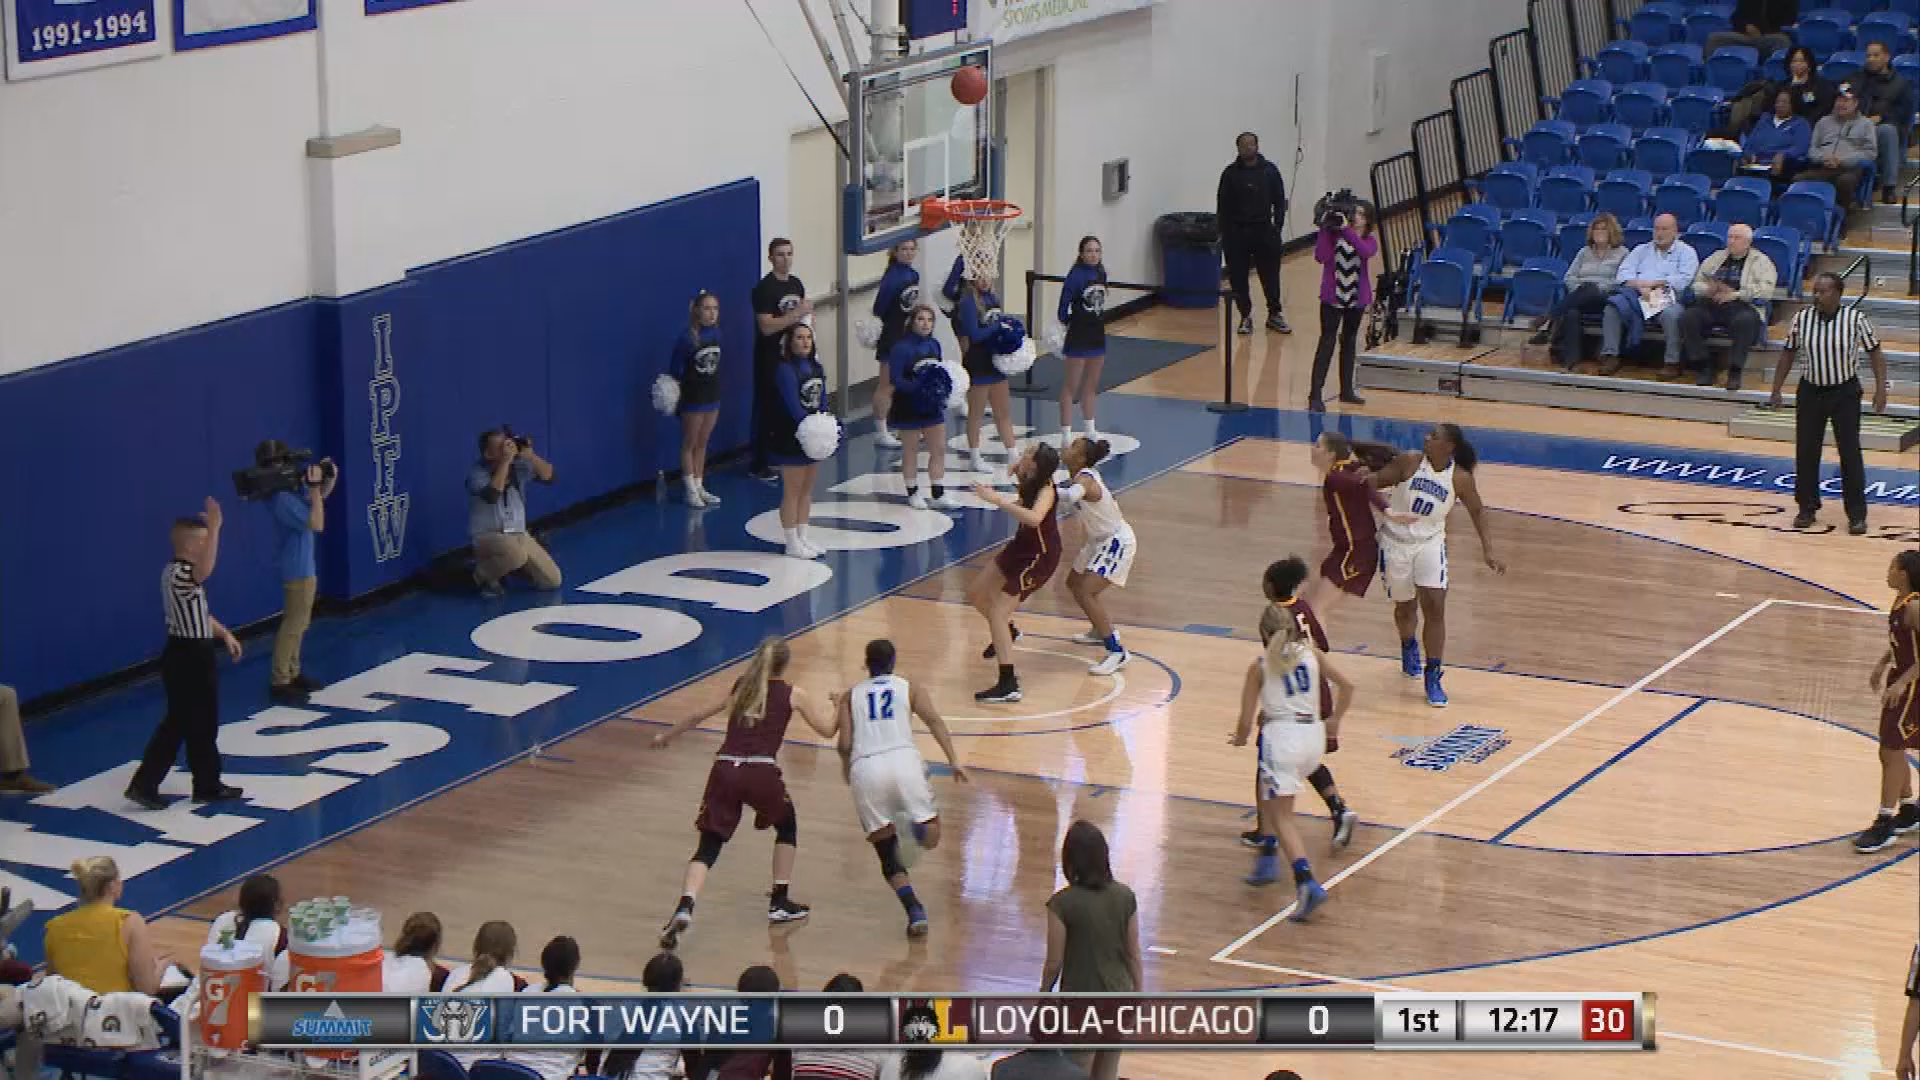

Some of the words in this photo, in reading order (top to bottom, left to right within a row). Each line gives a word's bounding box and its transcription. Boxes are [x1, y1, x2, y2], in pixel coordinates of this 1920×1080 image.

[32, 10, 148, 52] 1991-1994
[368, 313, 410, 563] IPFW
[1411, 497, 1434, 516] 00
[1283, 664, 1310, 697] 10
[868, 689, 894, 721] 12
